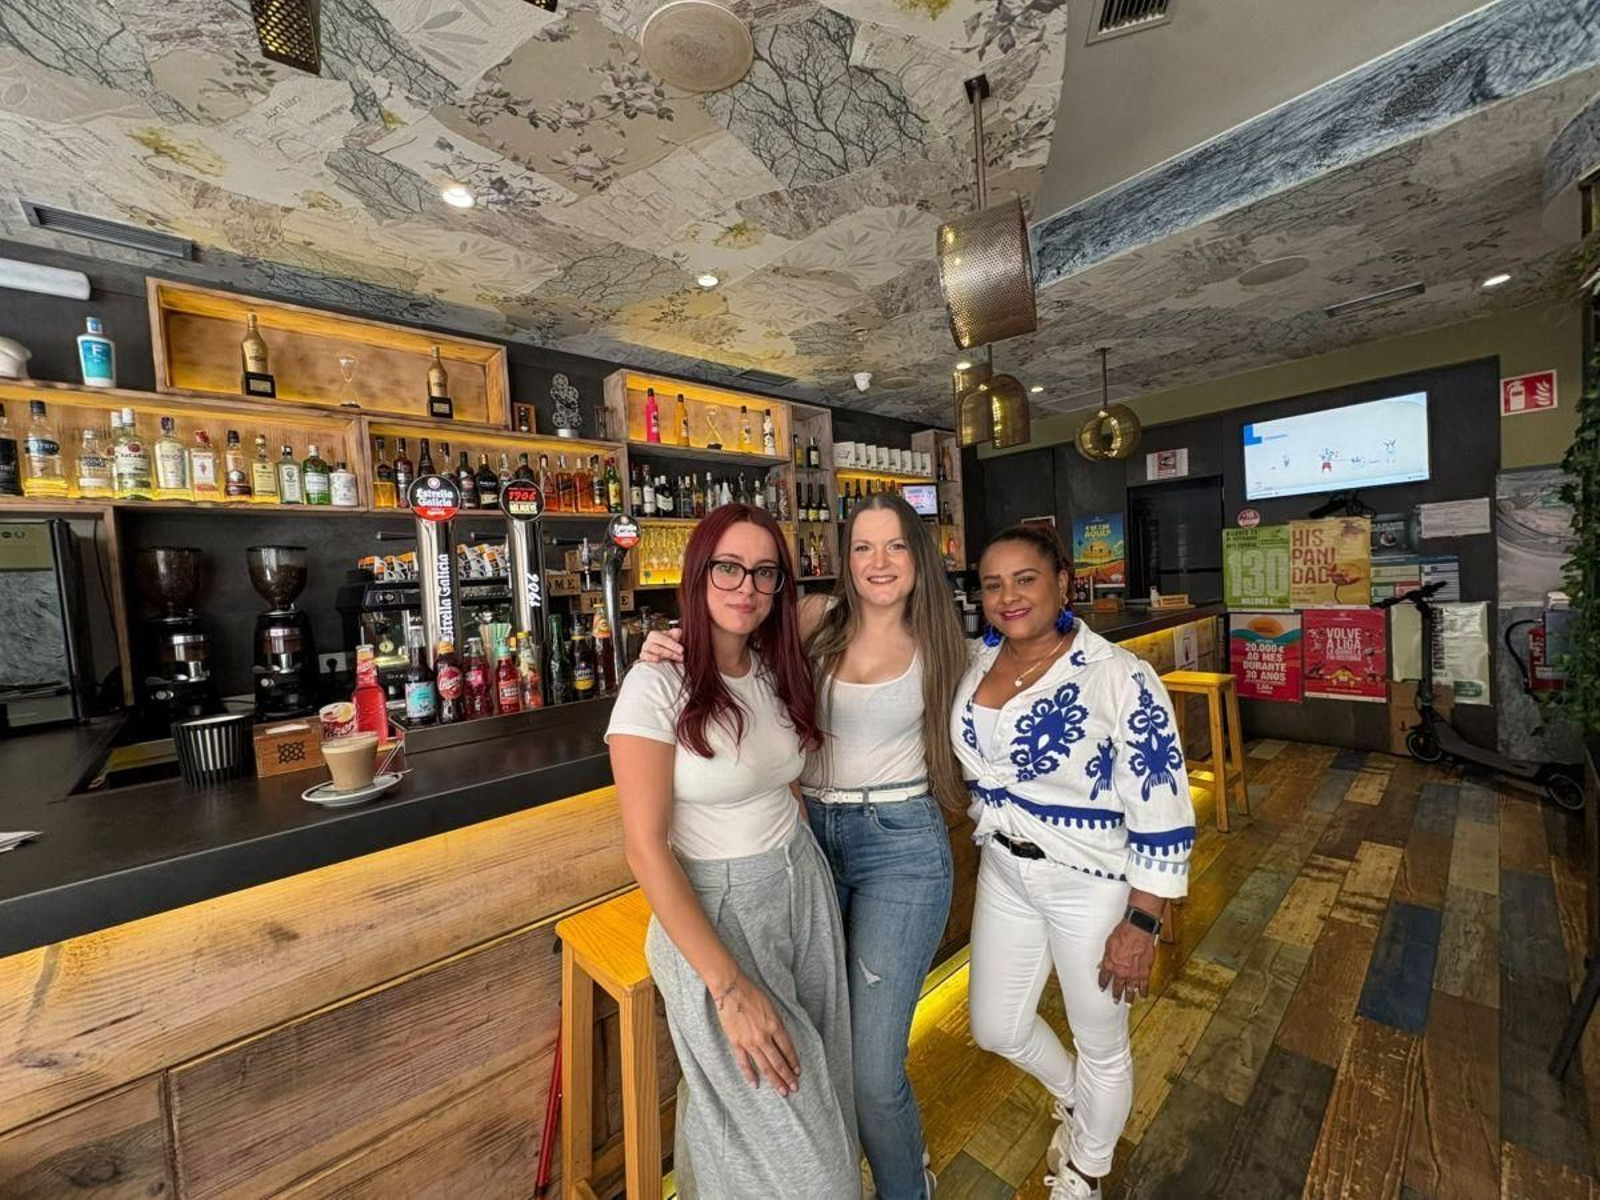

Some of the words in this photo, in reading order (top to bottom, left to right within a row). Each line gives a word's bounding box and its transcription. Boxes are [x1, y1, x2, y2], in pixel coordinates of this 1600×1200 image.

[415, 488, 454, 498] Estrella
[509, 491, 537, 501] 1906
[418, 497, 453, 507] Galicia
[1292, 528, 1323, 547] HIS
[438, 554, 452, 597] Galicia
[1228, 550, 1288, 597] 130
[1292, 565, 1329, 584] DAD
[526, 573, 541, 607] 1906
[439, 599, 454, 645] Estrella
[1326, 627, 1362, 640] VOLVE
[1326, 639, 1334, 650] A
[1337, 639, 1361, 650] LIGA
[1262, 653, 1283, 661] MES
[1243, 660, 1287, 672] DURANTE
